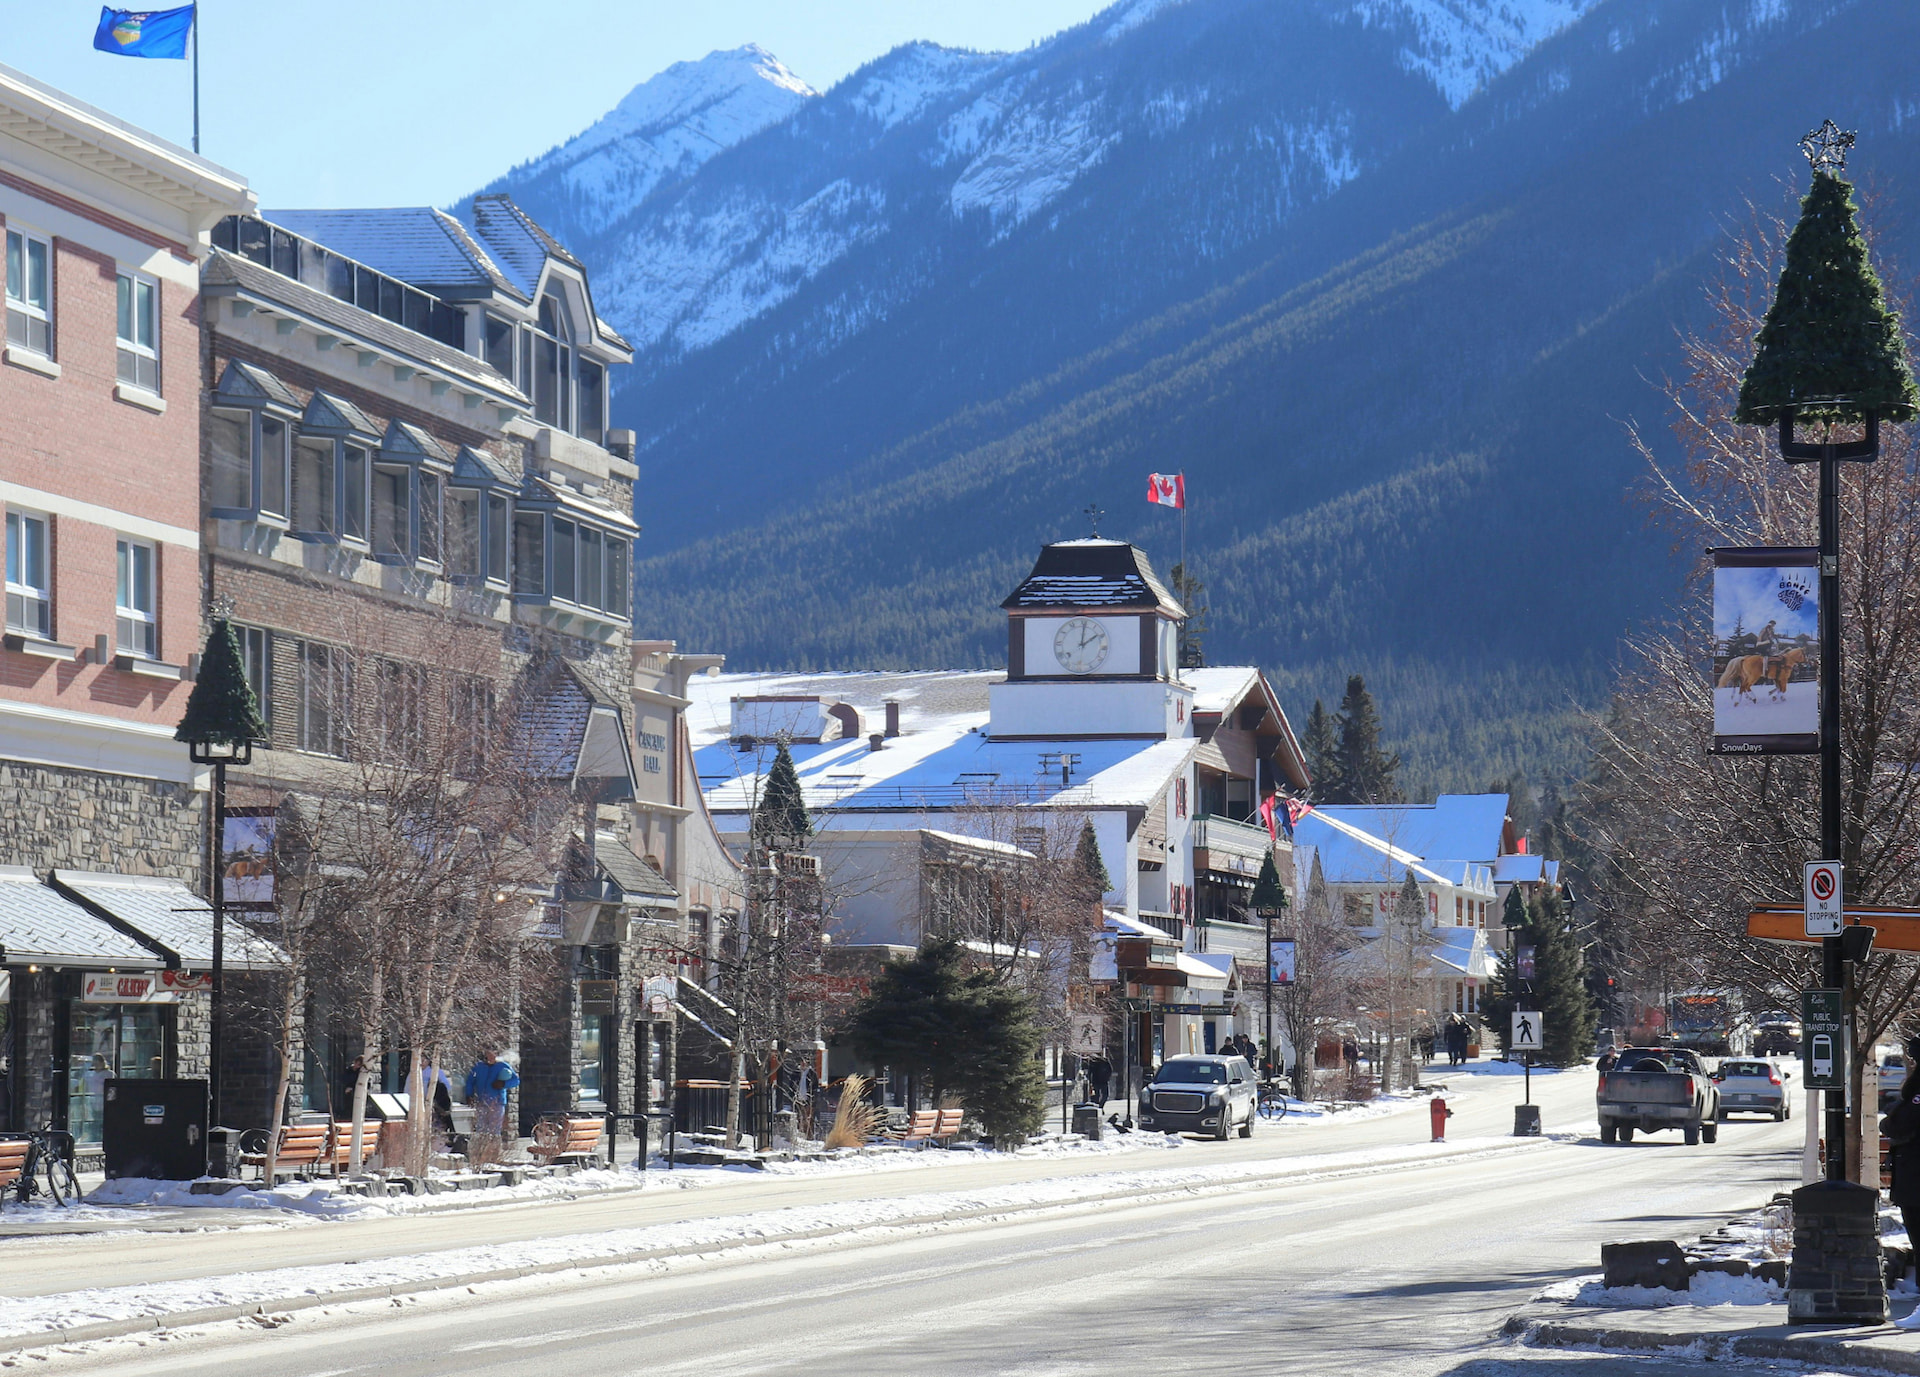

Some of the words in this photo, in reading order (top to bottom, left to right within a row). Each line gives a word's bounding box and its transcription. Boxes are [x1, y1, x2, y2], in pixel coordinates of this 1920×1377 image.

[1779, 581, 1810, 595] BANFF
[1721, 743, 1763, 752] SnowDays
[1819, 902, 1828, 910] NO
[1809, 912, 1839, 921] STOPPING
[1813, 1012, 1831, 1021] PUBLIC
[1805, 1023, 1825, 1032] TRANSIT
[1826, 1023, 1840, 1032] STOP
